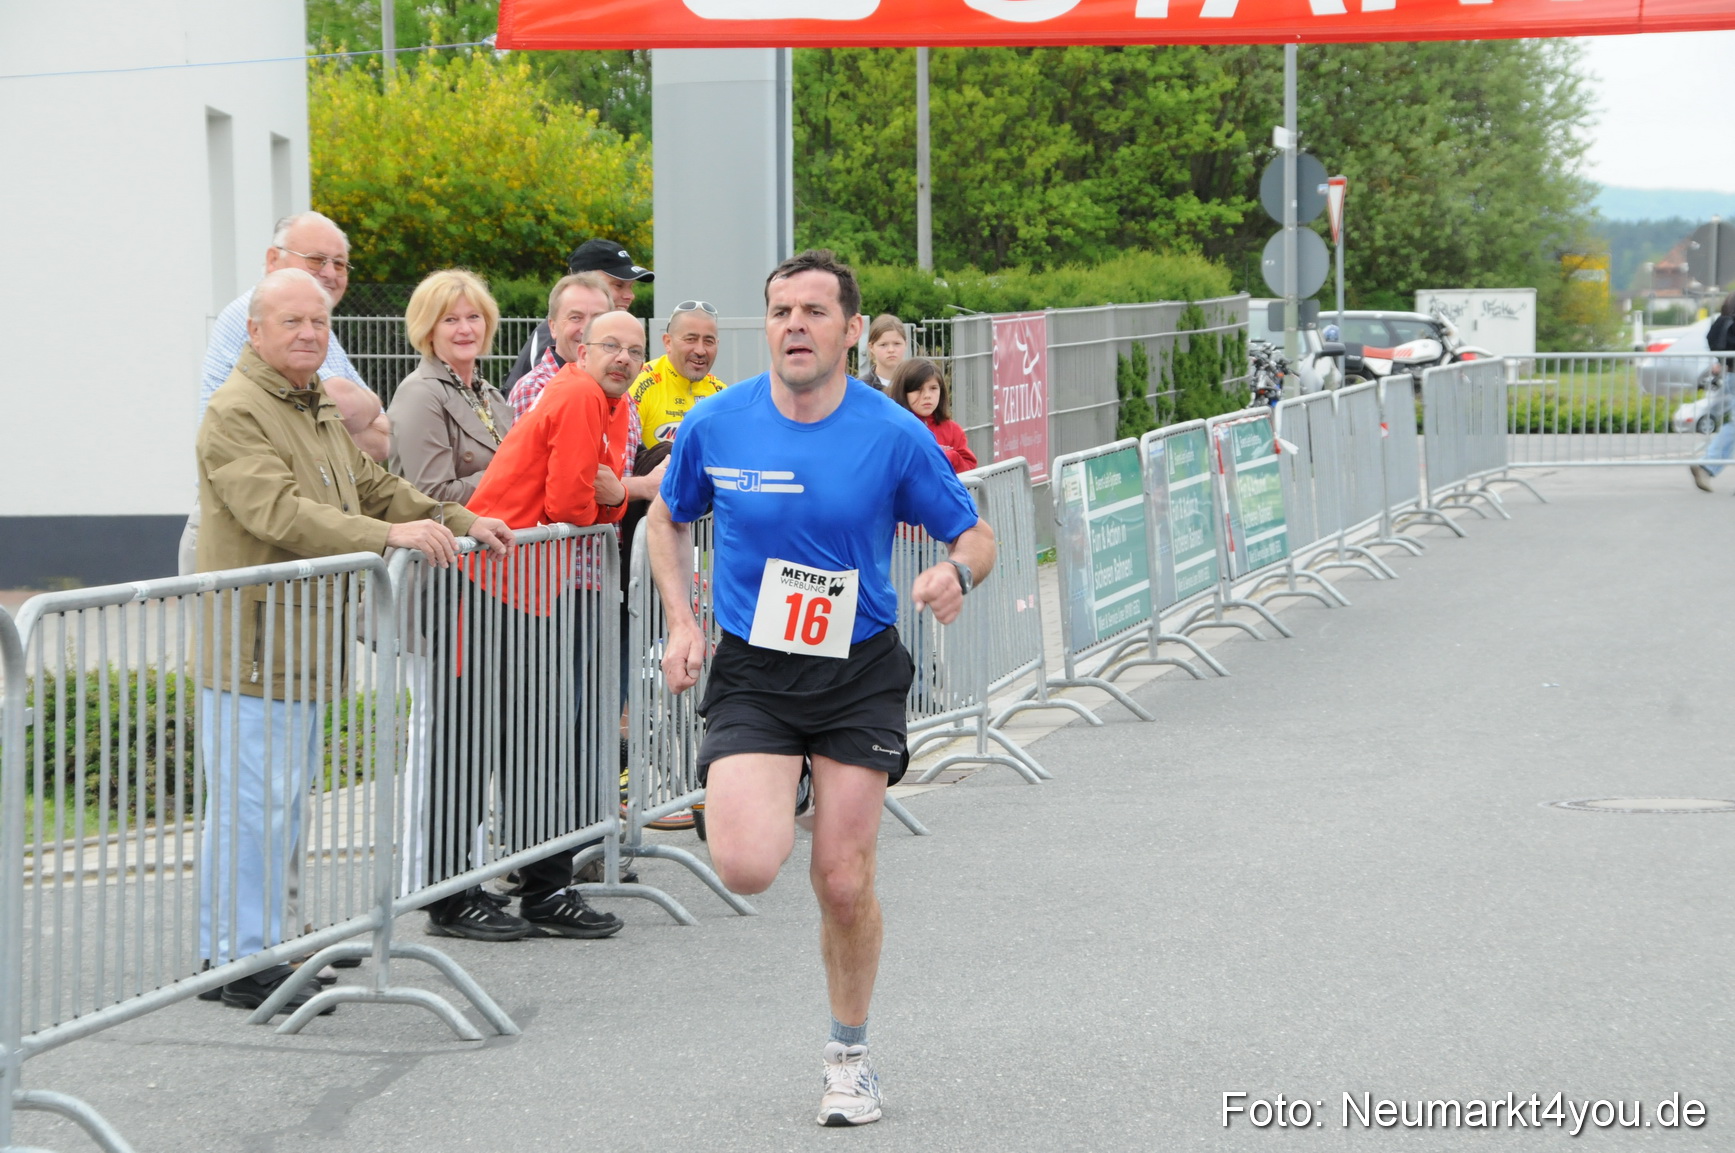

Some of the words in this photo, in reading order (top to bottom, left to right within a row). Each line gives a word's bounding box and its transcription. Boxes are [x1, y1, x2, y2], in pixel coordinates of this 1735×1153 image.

[1003, 380, 1043, 425] ZEITLOS
[780, 576, 826, 594] WERBUNG
[781, 566, 827, 586] MEYER
[784, 592, 832, 646] 16
